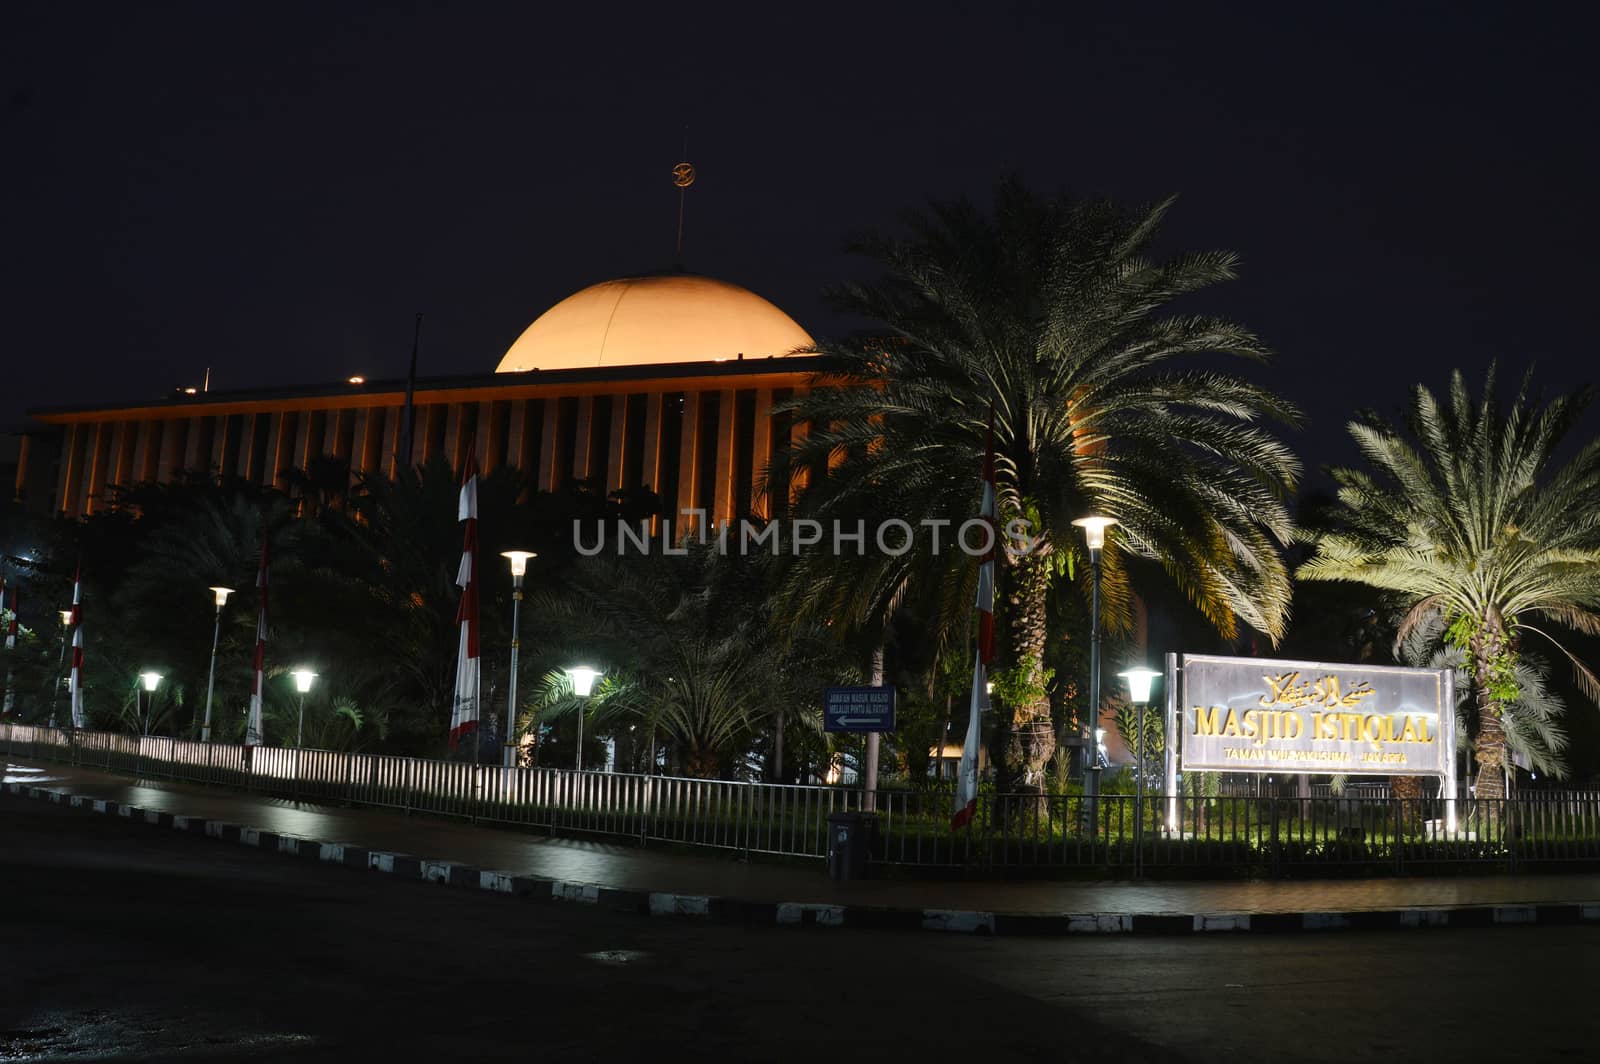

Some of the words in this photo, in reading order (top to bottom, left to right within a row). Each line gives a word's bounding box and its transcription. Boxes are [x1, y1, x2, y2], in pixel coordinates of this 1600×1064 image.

[1192, 705, 1304, 747] MASJID
[1311, 711, 1436, 750] ISTIQLAL
[1224, 747, 1266, 761] TAMAN
[1361, 751, 1408, 764] JAKARTA
